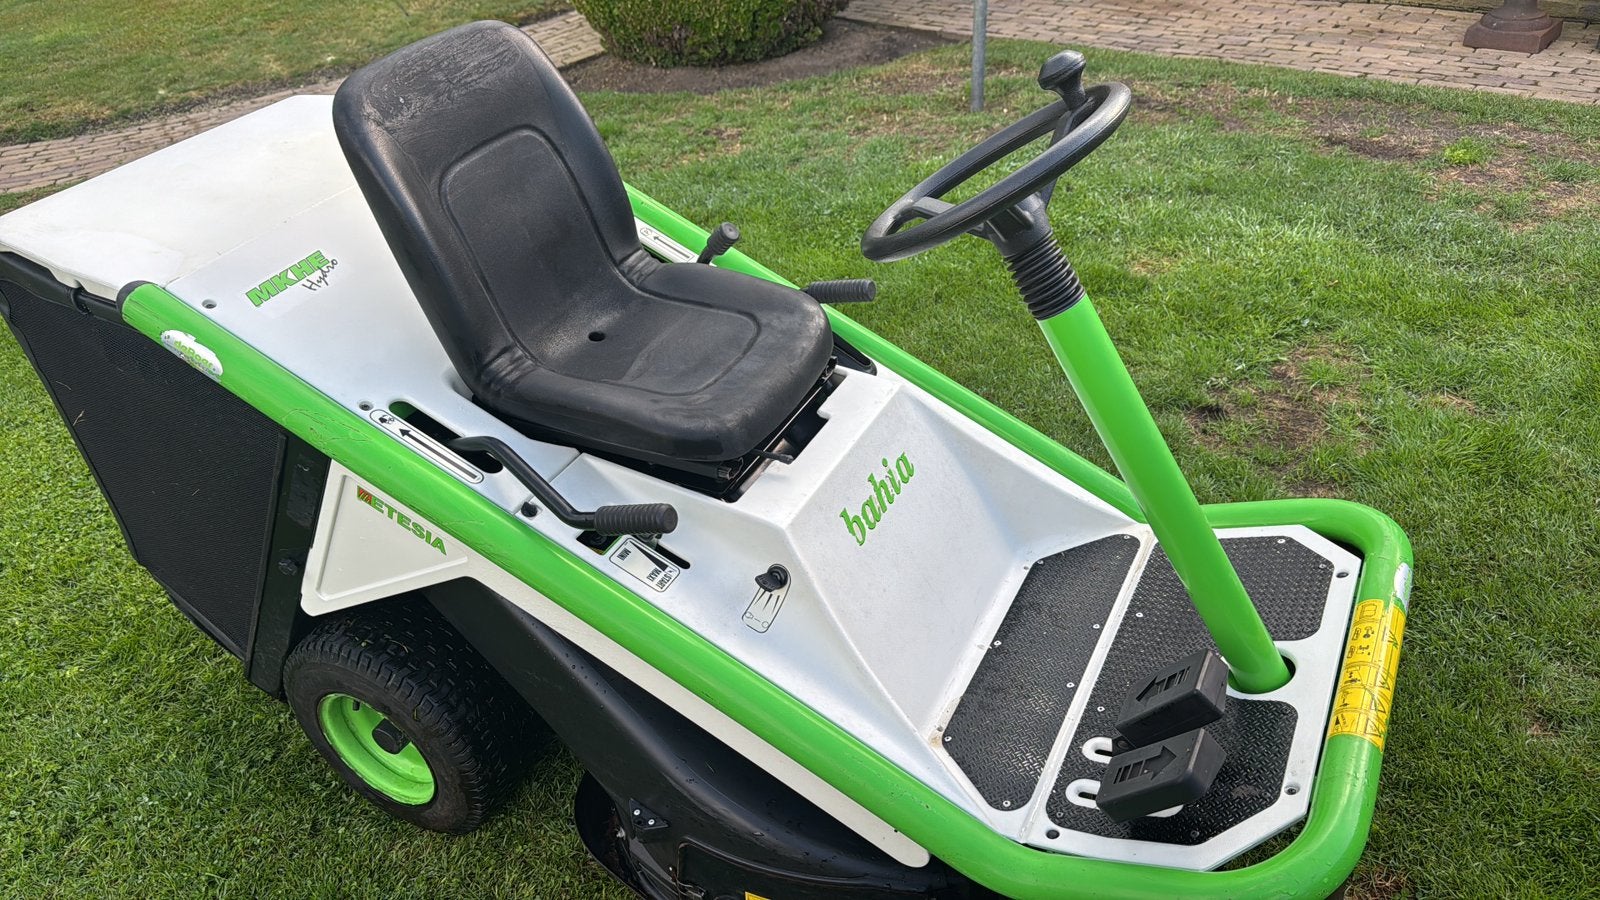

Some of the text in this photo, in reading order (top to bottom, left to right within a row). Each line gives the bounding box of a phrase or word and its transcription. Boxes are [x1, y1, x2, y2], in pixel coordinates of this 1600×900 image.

[245, 250, 330, 307] MKHE
[301, 259, 338, 291] Hydro
[839, 451, 914, 546] bahia
[616, 547, 632, 561] MINI
[646, 567, 662, 582] MAXI
[655, 573, 673, 590] START
